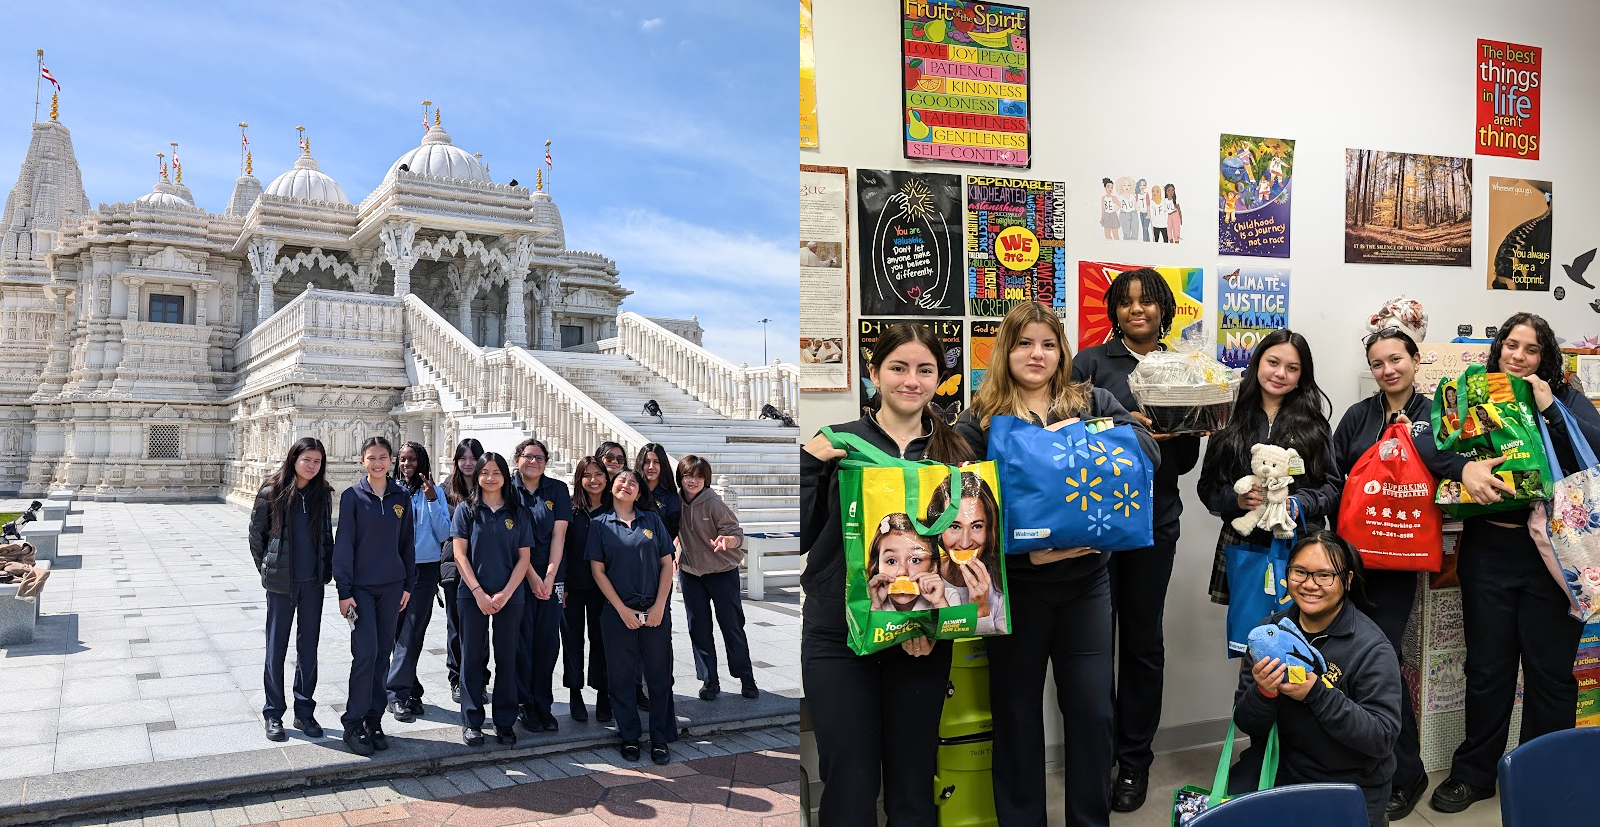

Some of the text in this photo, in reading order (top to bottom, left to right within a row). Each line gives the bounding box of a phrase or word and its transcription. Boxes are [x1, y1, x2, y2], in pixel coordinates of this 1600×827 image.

[904, 0, 1026, 32] Fruit of the Spirit
[908, 40, 948, 56] LOVE
[951, 46, 976, 60] JOY
[1482, 44, 1536, 64] The best
[982, 51, 1024, 66] PEACE
[930, 62, 997, 79] PATIENCE
[1480, 59, 1539, 92] things
[952, 80, 1022, 98] KINDNESS
[910, 94, 995, 112] GOODNESS
[1483, 83, 1532, 118] in life
[924, 112, 1026, 132] FAITHFULNESS
[1494, 116, 1522, 128] aren't
[934, 130, 1026, 147] GENTLENESS
[1479, 124, 1538, 156] things
[914, 144, 1024, 163] SELF-CONTROL
[967, 175, 1053, 190] DEPENDABLE
[1492, 182, 1514, 192] Wherever
[968, 185, 1026, 204] KINDHEARTED
[968, 200, 1026, 217] astonishing
[1036, 194, 1044, 238] DAZZLING
[1053, 182, 1065, 239] EMPOWERED
[894, 225, 908, 236] You
[968, 210, 978, 252] COOPERATIVE
[978, 210, 988, 252] ELECTRIC
[1234, 216, 1274, 232] Childhood
[1240, 232, 1246, 240] is
[1254, 224, 1286, 236] journey
[893, 236, 925, 246] valuable.
[1000, 234, 1033, 252] WE
[1248, 238, 1262, 246] not
[1269, 236, 1284, 244] race
[886, 250, 931, 264] anyone make
[892, 244, 924, 255] Don't let
[1004, 252, 1034, 262] are...
[1512, 246, 1550, 264] You always
[890, 258, 930, 274] you believe
[1512, 258, 1529, 272] leave
[968, 266, 976, 298] CARING
[976, 266, 984, 298] RELIABLE
[1053, 246, 1066, 307] Fantastic
[1228, 276, 1280, 292] CLIMATE
[1512, 270, 1544, 290] footprint.
[1005, 288, 1026, 300] COOL
[1174, 302, 1199, 319] nity
[1222, 292, 1286, 313] JUSTICE
[974, 324, 988, 333] God
[1500, 440, 1524, 450] ALWAYS
[1382, 490, 1428, 498] SUPERMARKET
[1383, 482, 1428, 492] SUPERKING
[1366, 520, 1421, 529] www.superking.ca
[1580, 634, 1600, 643] words.
[1578, 657, 1600, 666] actions.
[1578, 678, 1598, 686] habits.
